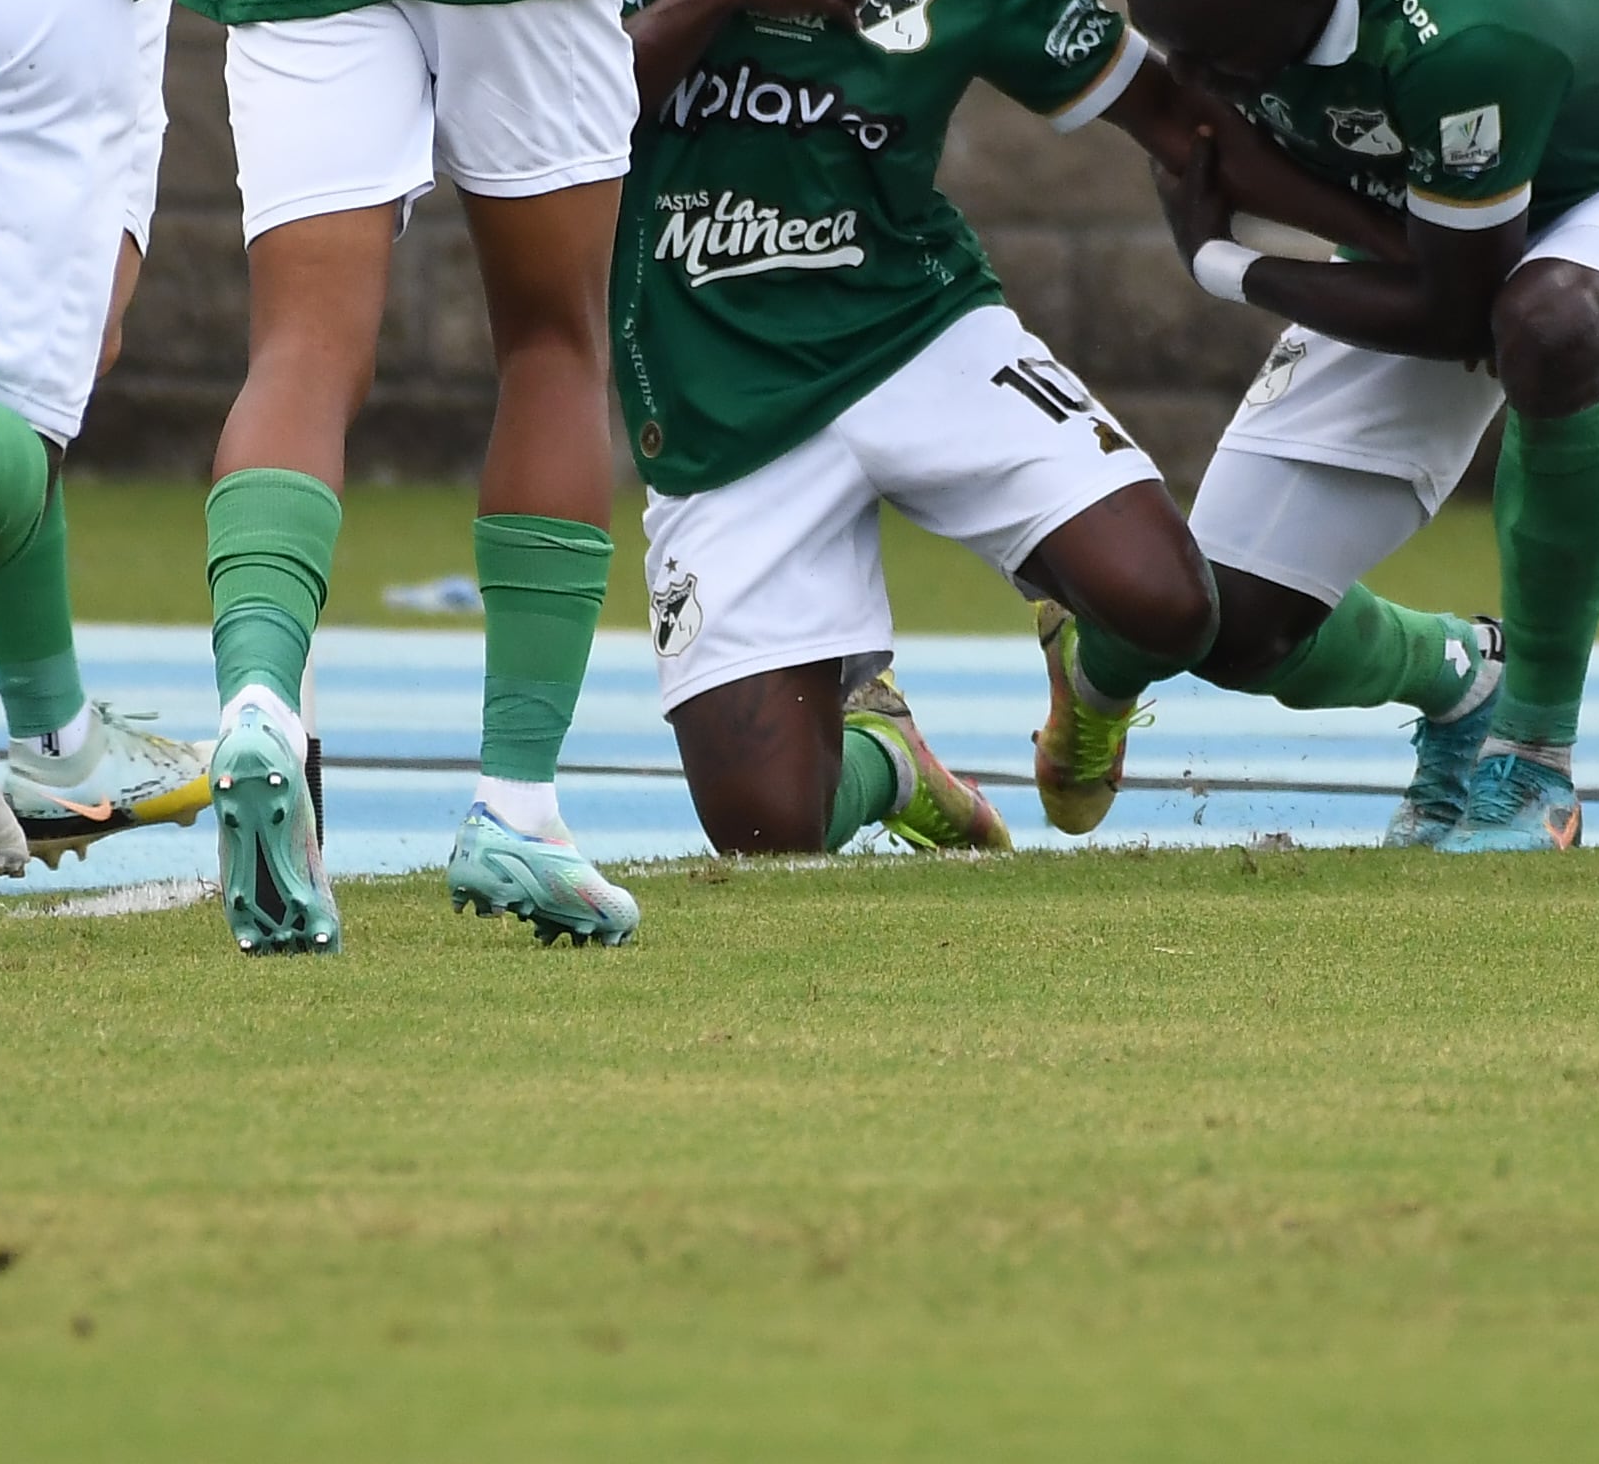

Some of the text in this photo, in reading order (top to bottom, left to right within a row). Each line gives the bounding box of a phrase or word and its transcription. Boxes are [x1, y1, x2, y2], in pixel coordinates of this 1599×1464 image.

[654, 191, 710, 212] PASTAS
[715, 191, 754, 221] La
[654, 208, 858, 276] Muñeca
[990, 356, 1095, 425] 10
